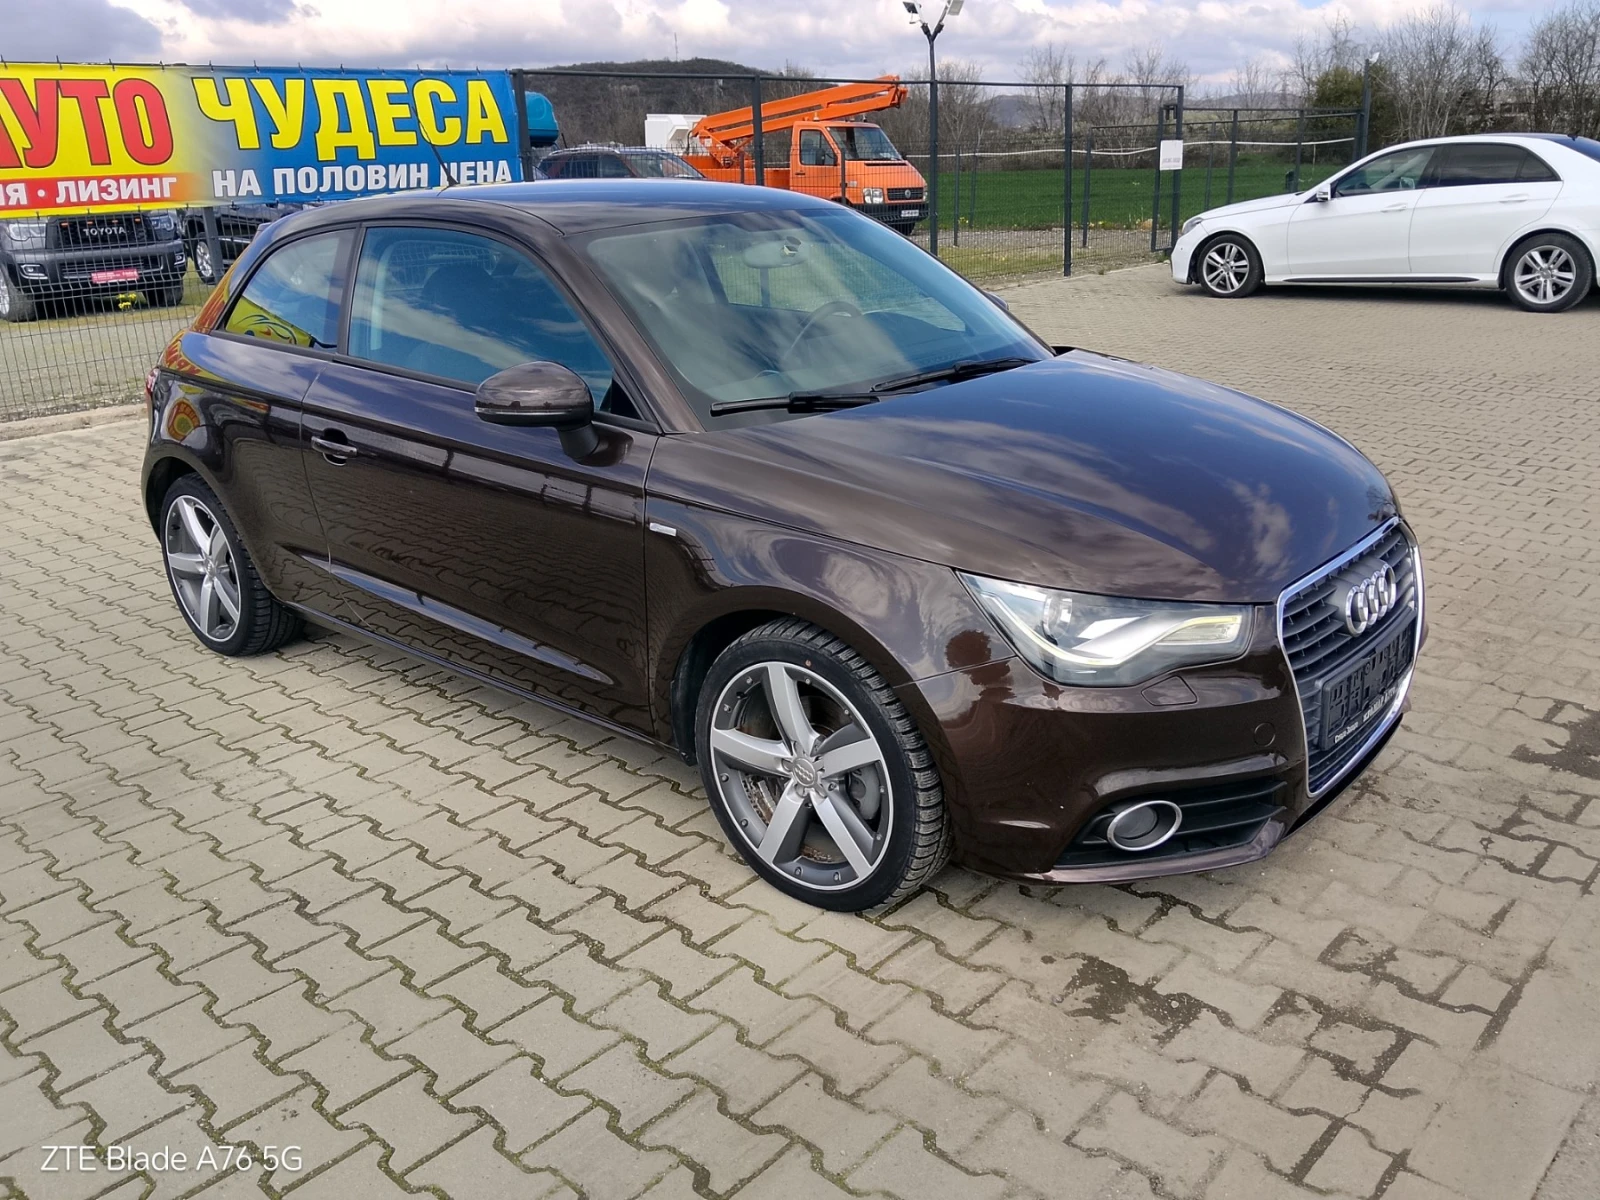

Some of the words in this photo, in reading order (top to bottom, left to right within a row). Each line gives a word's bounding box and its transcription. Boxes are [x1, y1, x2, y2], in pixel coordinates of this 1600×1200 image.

[191, 77, 509, 162] ЧУДЕСА
[0, 183, 28, 206] Я
[56, 177, 177, 204] ЛИЗИНГ
[212, 169, 262, 198] НА
[273, 163, 429, 195] ПОЛОВИН
[83, 226, 127, 236] TOYOTA
